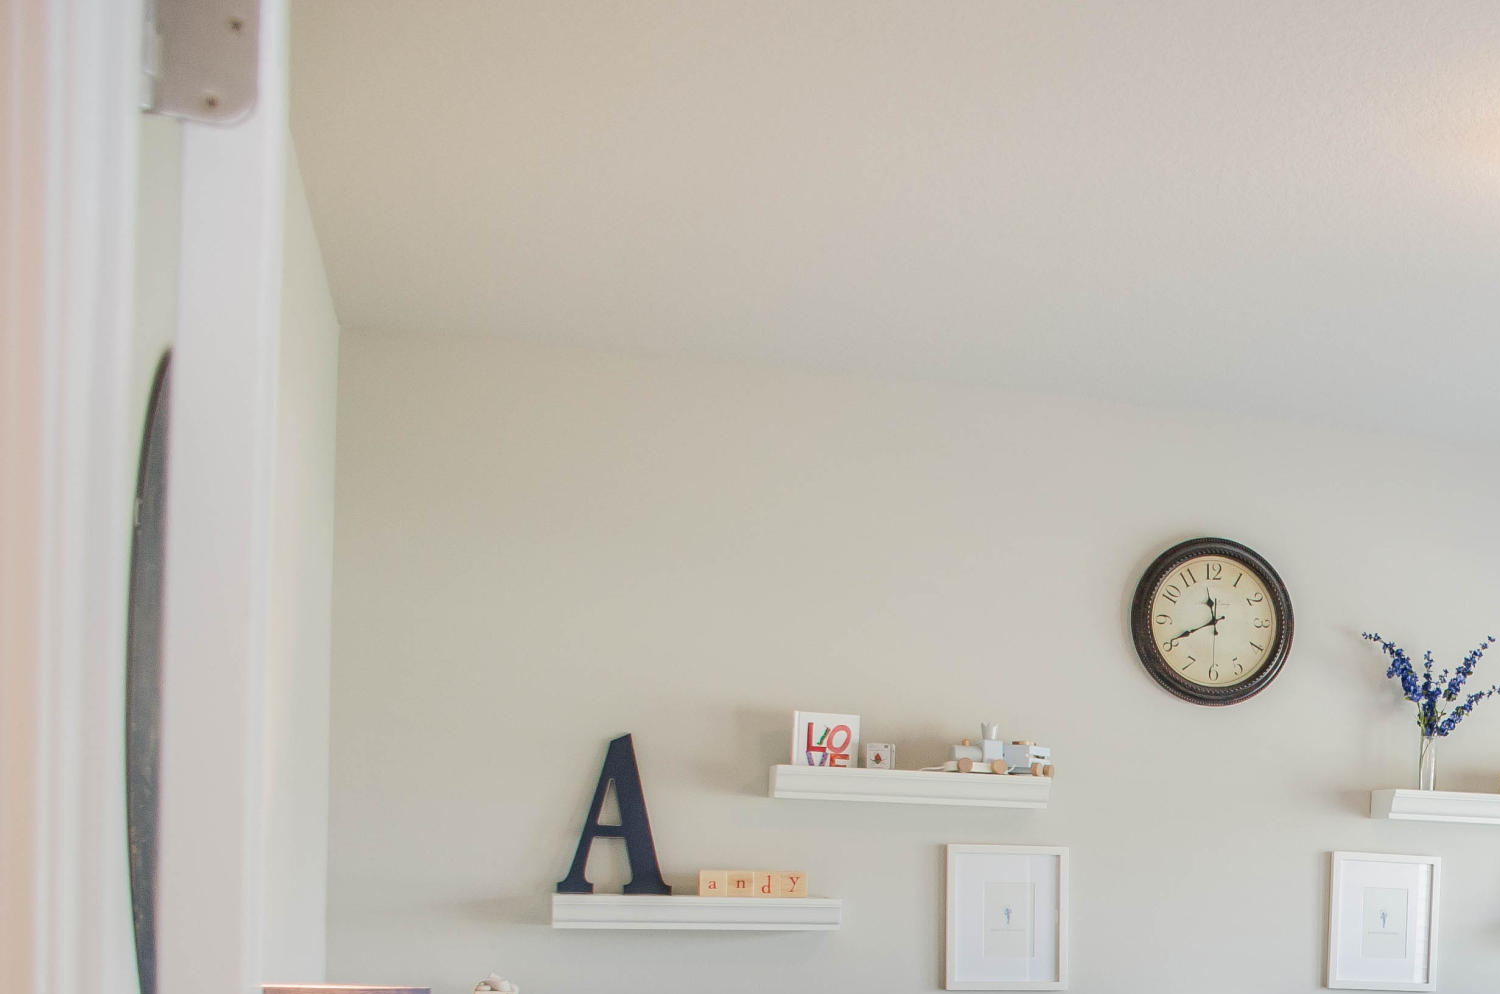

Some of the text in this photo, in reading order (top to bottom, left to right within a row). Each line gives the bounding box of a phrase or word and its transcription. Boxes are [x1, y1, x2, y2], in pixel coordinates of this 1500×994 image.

[1179, 568, 1197, 587] 11
[1206, 563, 1222, 580] 12
[1233, 573, 1243, 588] 1
[1162, 584, 1182, 606] 10
[1246, 592, 1264, 606] 2
[1155, 614, 1173, 625] 9
[1254, 617, 1271, 629] 3
[1163, 639, 1180, 652] 8
[1182, 655, 1197, 671] 7
[1232, 657, 1243, 675] 5
[1208, 664, 1219, 681] 6
[556, 733, 672, 896] A
[707, 874, 801, 894] andy
